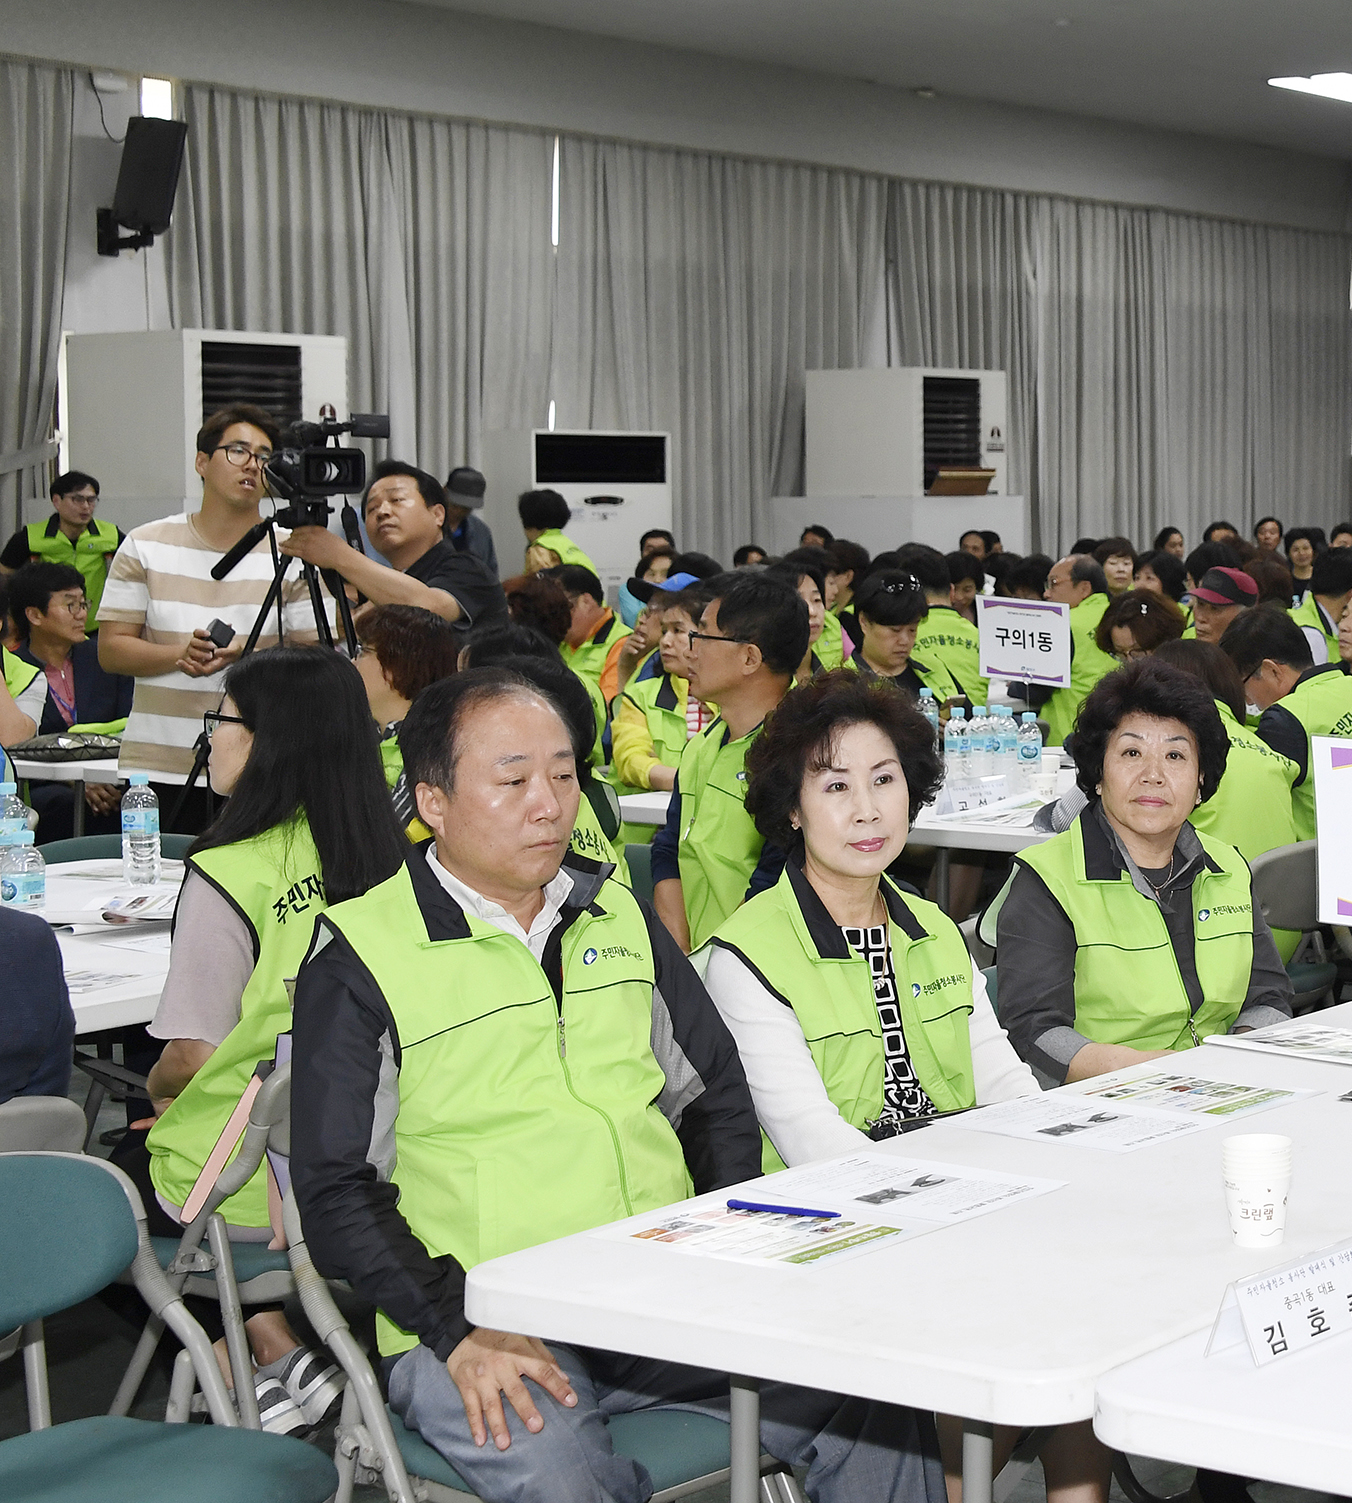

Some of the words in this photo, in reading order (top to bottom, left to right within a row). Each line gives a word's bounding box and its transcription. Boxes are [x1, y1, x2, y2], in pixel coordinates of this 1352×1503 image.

[995, 627, 1053, 653] 구의1동
[1240, 1203, 1274, 1221] 크린랩
[1283, 1288, 1314, 1311] 중곡1동
[1317, 1280, 1336, 1296] 대표
[1263, 1320, 1289, 1355] 김
[1306, 1307, 1331, 1338] 호
